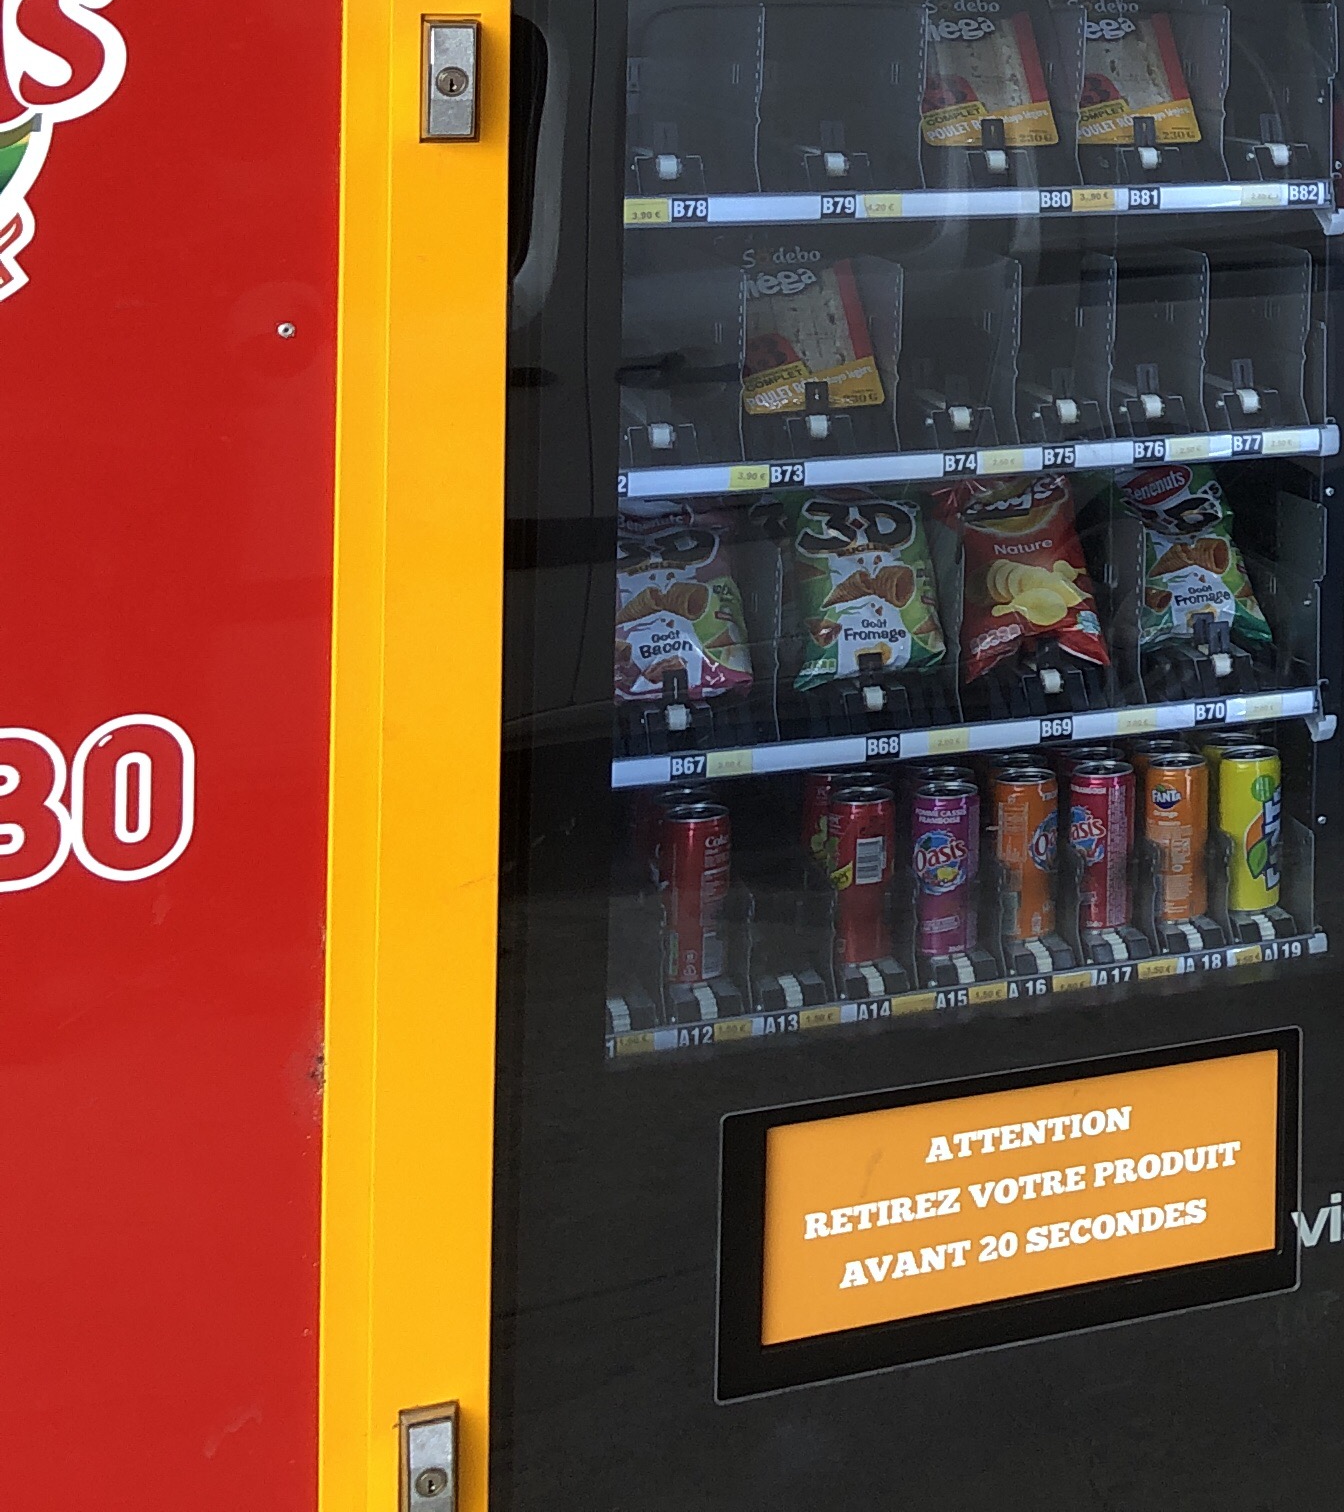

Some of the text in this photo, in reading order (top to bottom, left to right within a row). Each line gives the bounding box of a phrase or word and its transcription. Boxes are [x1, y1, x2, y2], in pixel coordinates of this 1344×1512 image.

[926, 104, 981, 126] COMPLET
[927, 117, 970, 141] POULET
[1040, 190, 1071, 208] B80
[1130, 189, 1159, 206] B81
[1289, 185, 1317, 201] B82
[673, 200, 707, 218] B78
[823, 196, 855, 214] B79
[1135, 442, 1164, 459] B76
[1233, 435, 1261, 452] B77
[945, 455, 976, 472] B74
[1044, 449, 1074, 466] B75
[771, 466, 803, 484] B73
[994, 538, 1053, 555] Nature
[1173, 591, 1231, 608] Fromage
[844, 628, 907, 642] Fromage
[639, 640, 694, 659] Bacon
[1196, 703, 1225, 720] B70
[1042, 719, 1072, 737] B69
[867, 737, 899, 754] B68
[672, 756, 706, 775] B67
[1152, 789, 1182, 804] FANTA
[914, 838, 968, 872] Oasis
[935, 991, 968, 1009] A15
[857, 1001, 891, 1021] A14
[764, 1016, 799, 1035] A13
[679, 1027, 713, 1047] A12
[925, 1105, 1132, 1164] ATTENTION
[804, 1140, 1241, 1240] RETIREZ VOTRE PRODUIT
[838, 1199, 1208, 1289] AVANT 20 SECONDES
